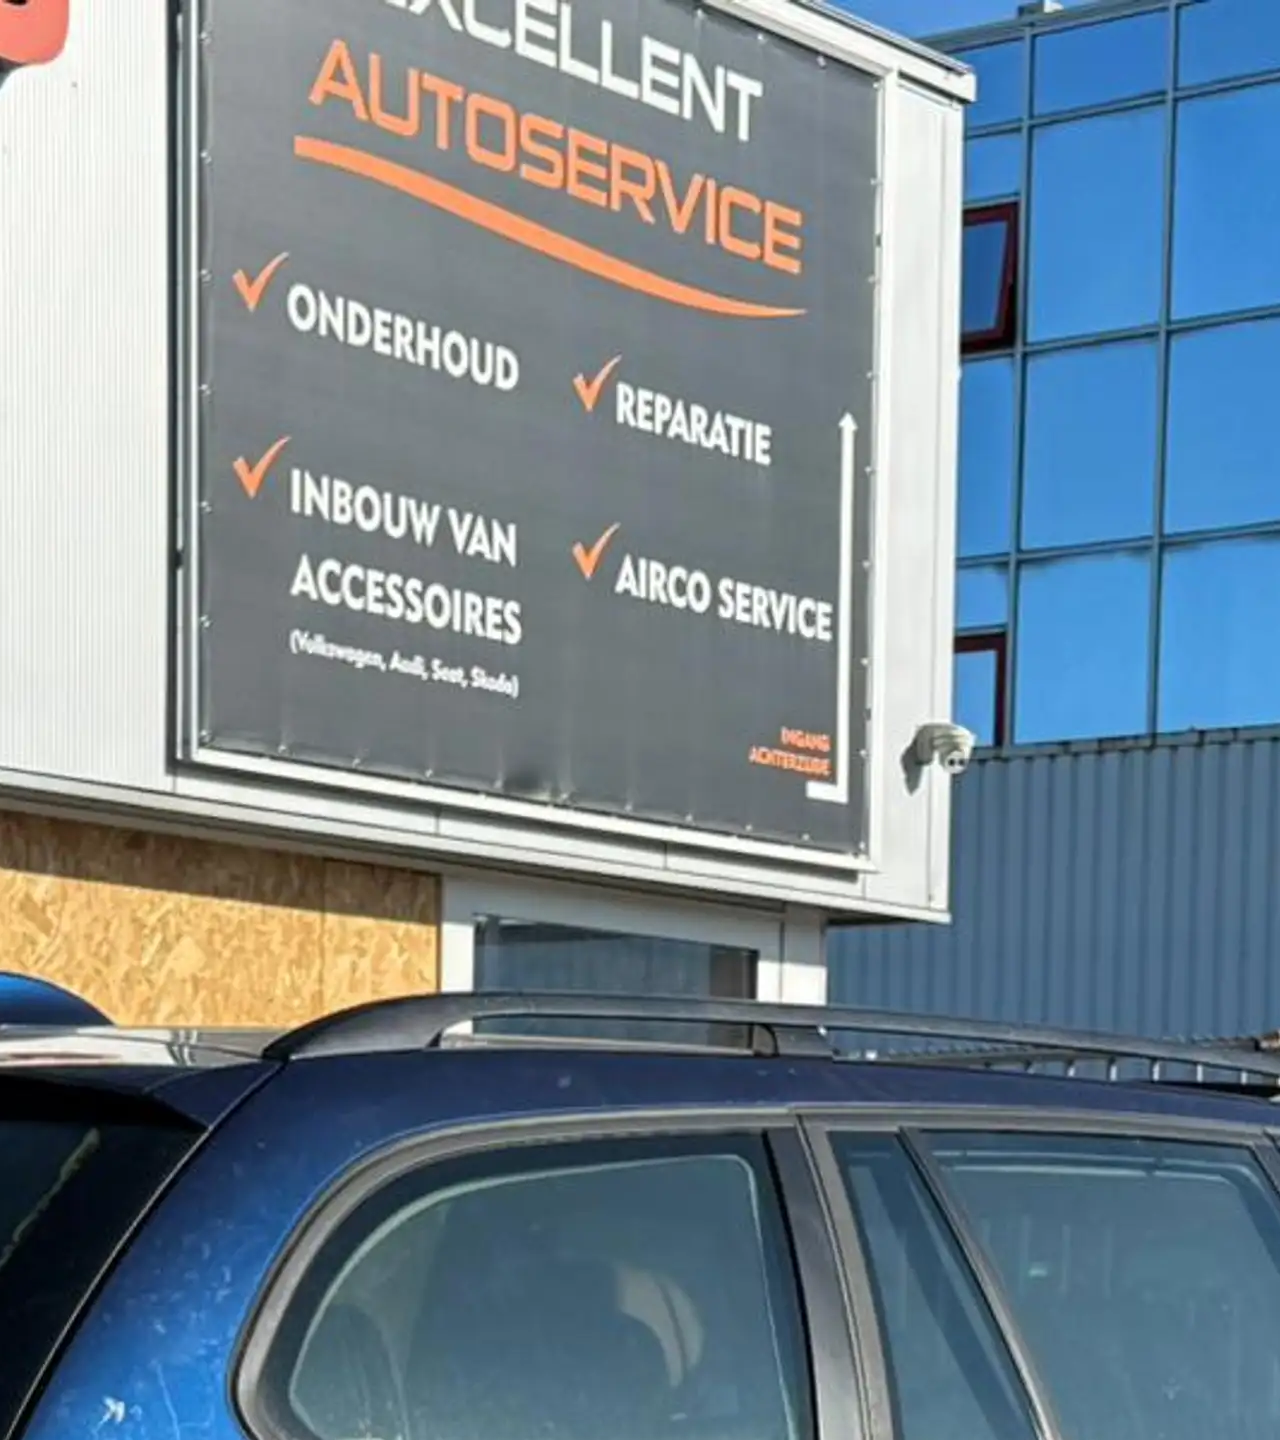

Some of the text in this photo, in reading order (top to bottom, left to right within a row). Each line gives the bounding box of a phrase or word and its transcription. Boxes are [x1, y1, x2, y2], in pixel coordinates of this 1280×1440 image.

[384, 0, 763, 142] CELLENT
[308, 39, 803, 275] AUTOSERVICE
[287, 283, 520, 391] ONDERHOUD
[616, 386, 772, 466] REPARATIE
[291, 468, 517, 568] INBOUW VAN
[290, 552, 522, 645] ACCESSOIRES
[615, 553, 833, 642] AIRCO SERVICE
